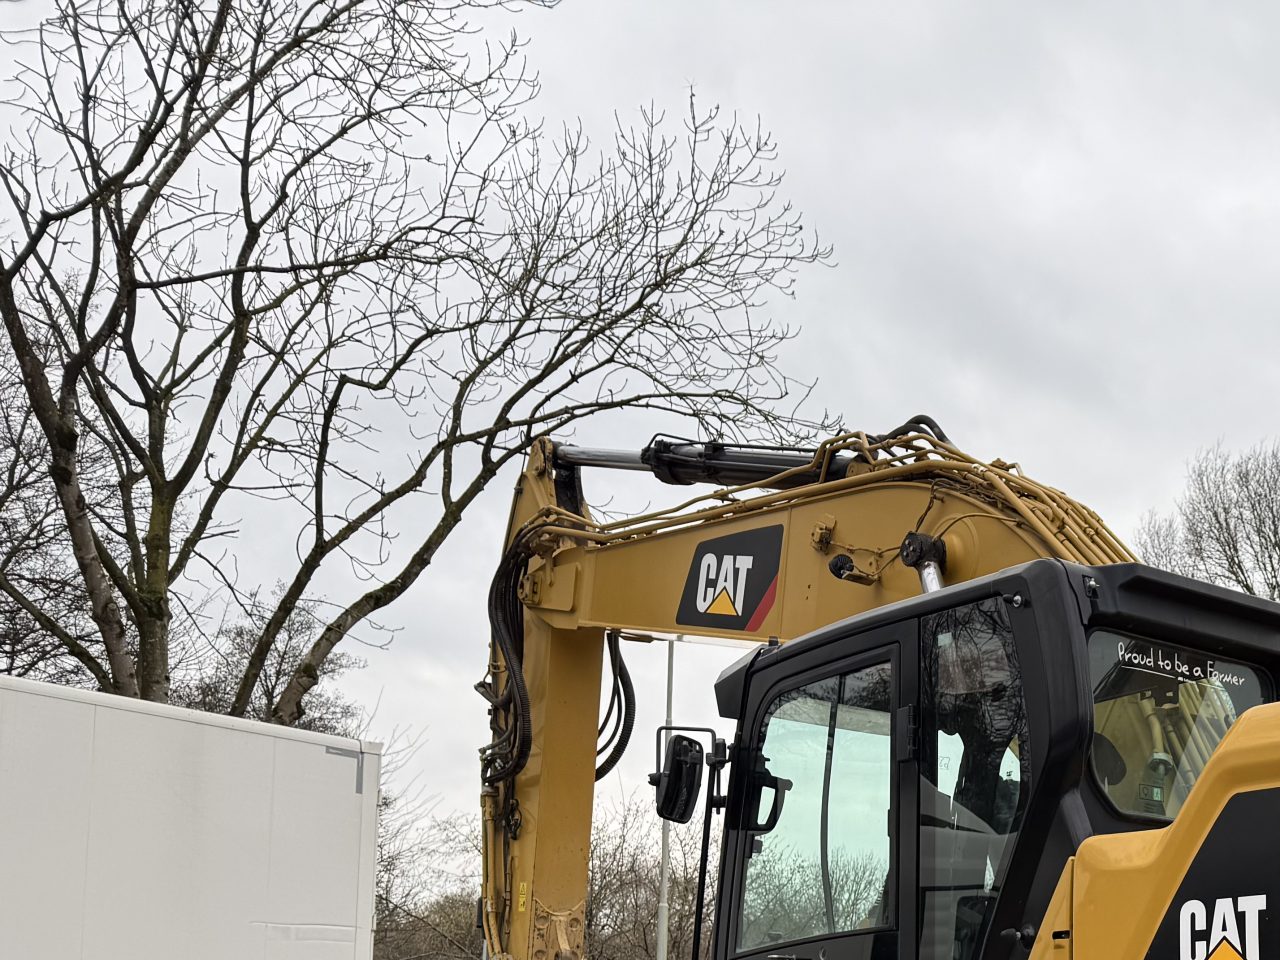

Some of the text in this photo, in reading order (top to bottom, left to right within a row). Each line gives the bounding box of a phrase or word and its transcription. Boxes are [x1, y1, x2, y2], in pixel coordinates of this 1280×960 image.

[696, 553, 753, 616] CAT
[1117, 642, 1245, 686] Proud to be a Farmer
